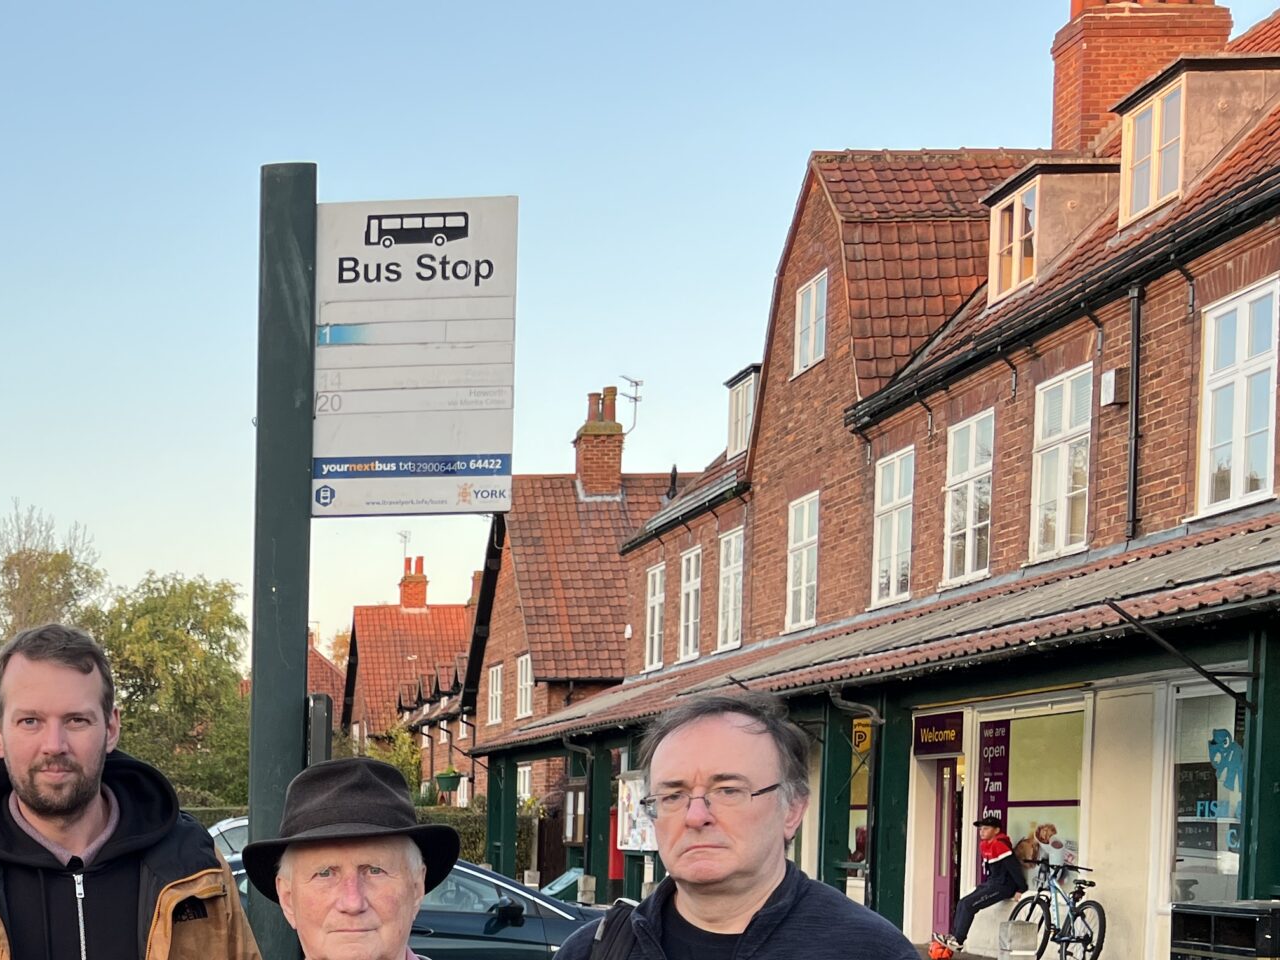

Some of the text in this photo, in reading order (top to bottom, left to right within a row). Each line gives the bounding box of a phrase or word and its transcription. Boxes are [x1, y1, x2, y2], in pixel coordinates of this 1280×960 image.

[337, 253, 494, 287] Bus Stop
[318, 393, 342, 413] 20
[322, 461, 396, 475] yournextbus
[457, 461, 467, 470] to
[469, 459, 502, 470] 64422
[473, 489, 507, 500] YORK
[920, 726, 956, 743] Welcome
[983, 727, 1006, 737] we are
[983, 745, 1006, 763] open
[984, 777, 1002, 792] 7am
